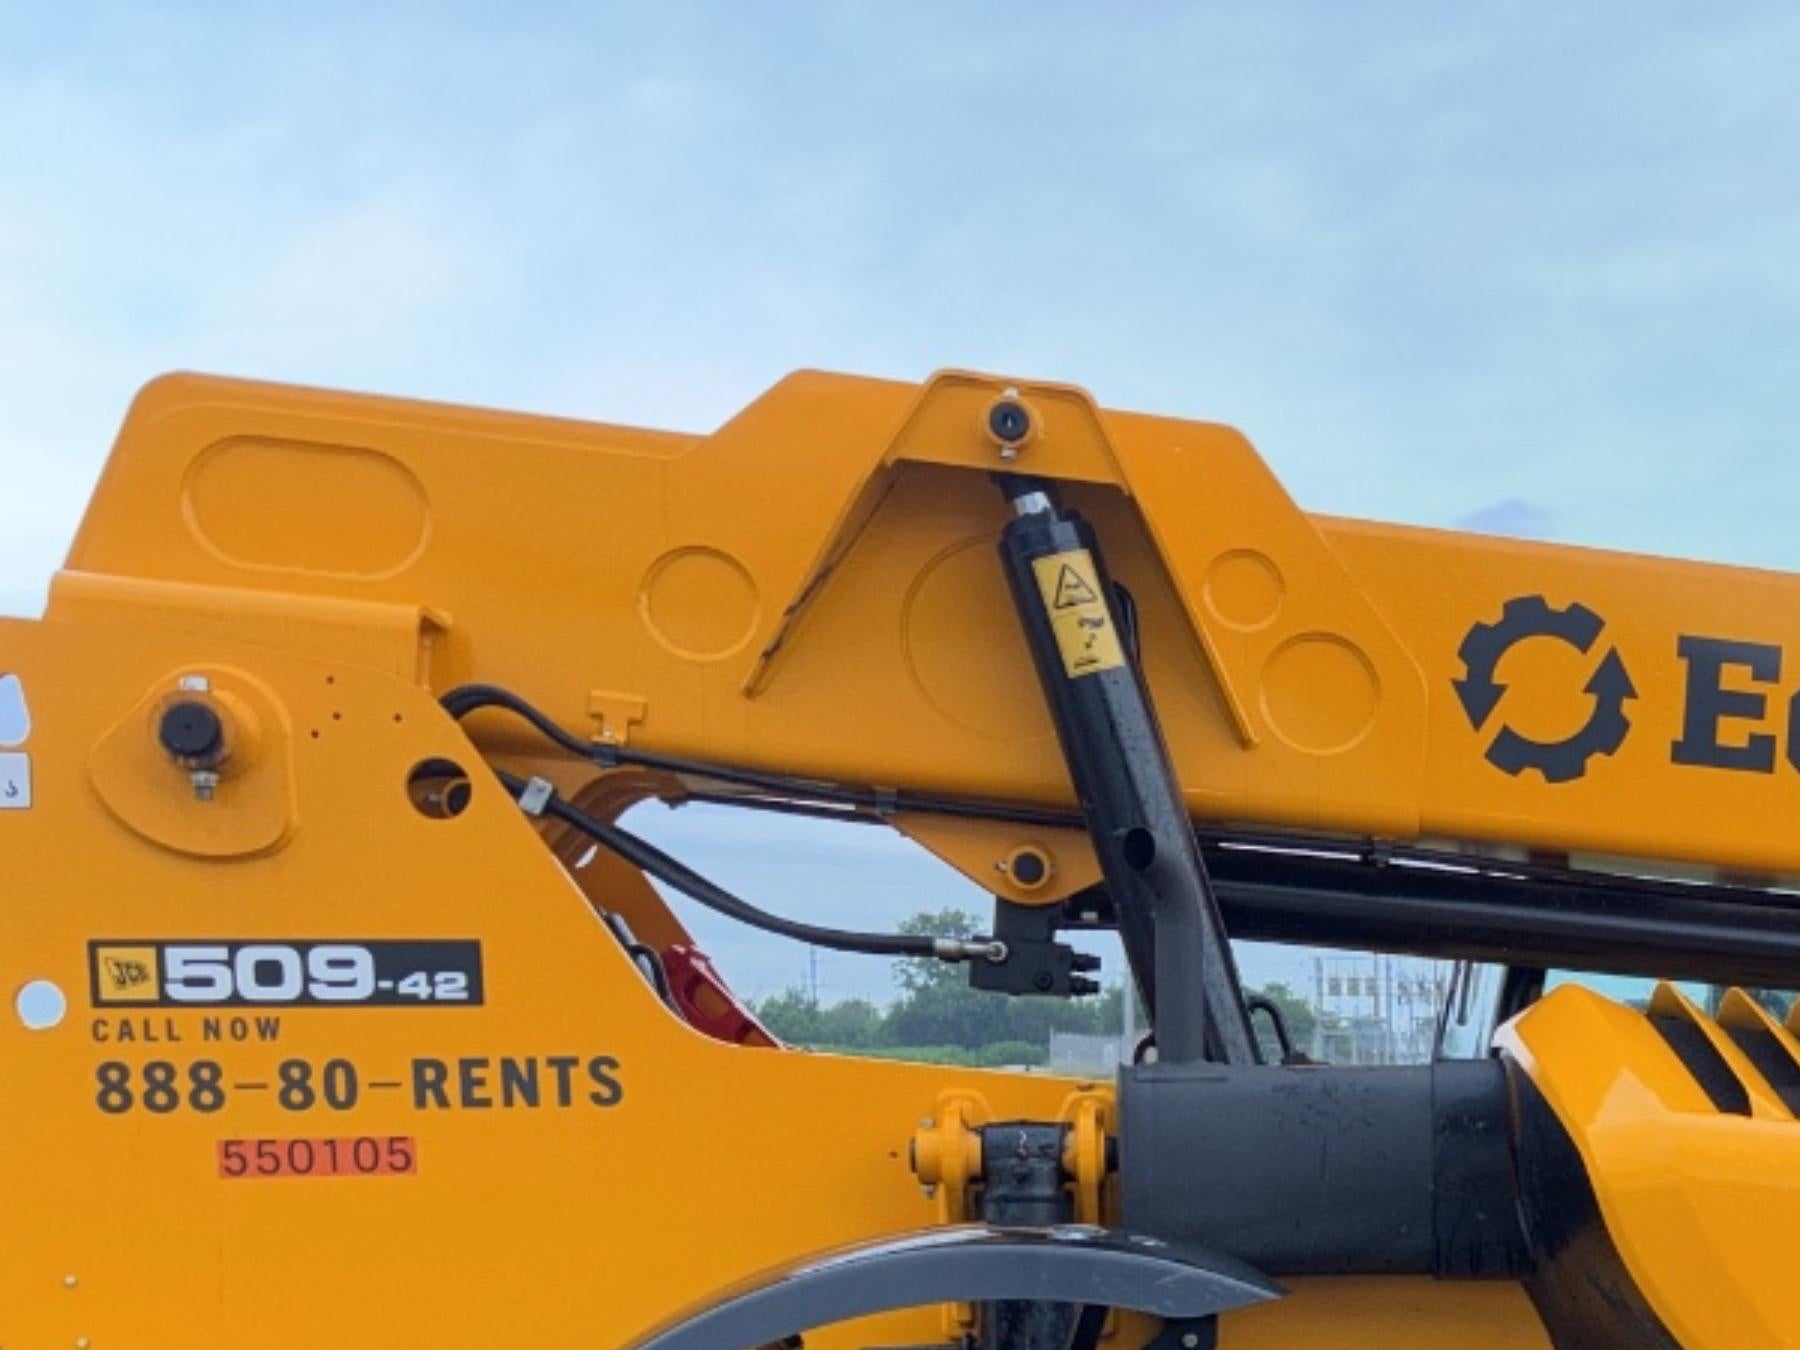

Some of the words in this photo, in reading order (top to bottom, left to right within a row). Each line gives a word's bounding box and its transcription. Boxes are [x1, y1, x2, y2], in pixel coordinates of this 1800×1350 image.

[164, 945, 469, 1001] 509-42
[92, 1018, 182, 1042] CALL
[203, 1017, 282, 1041] NOW
[95, 1056, 623, 1113] 888-80-RENTS
[222, 1137, 413, 1176] 550105
